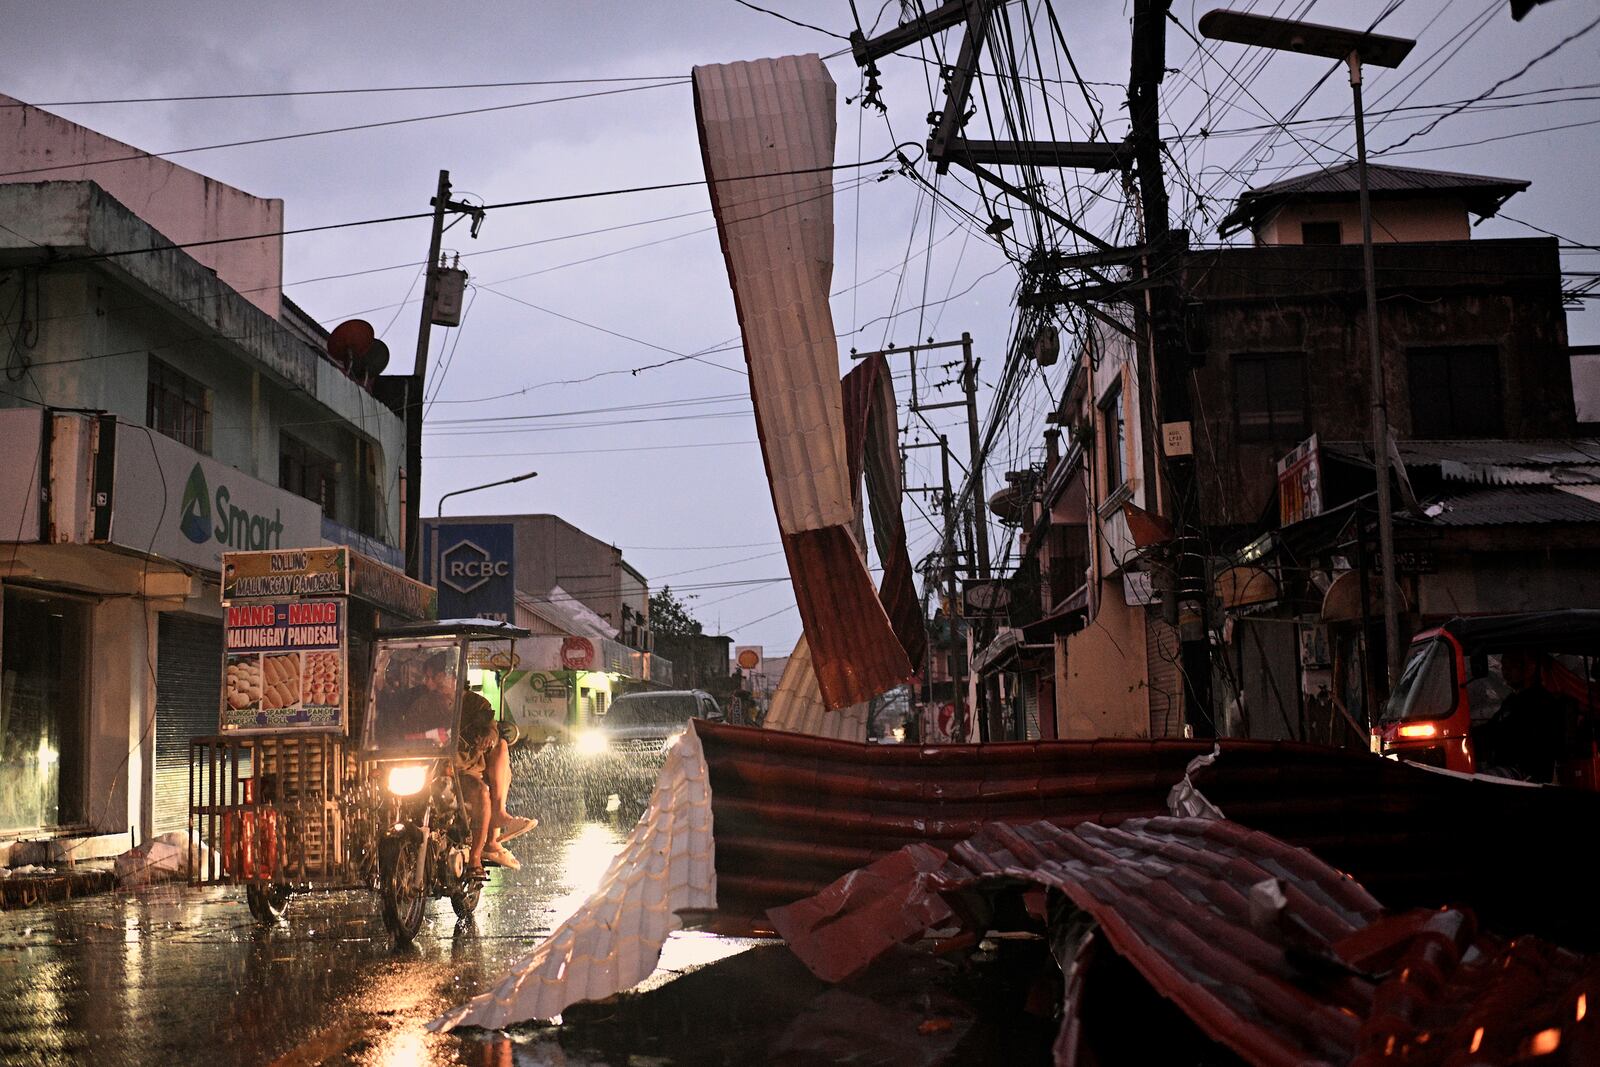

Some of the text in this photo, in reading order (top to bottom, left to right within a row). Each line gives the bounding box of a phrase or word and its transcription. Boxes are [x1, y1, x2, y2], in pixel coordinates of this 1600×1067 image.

[214, 485, 284, 551] Smart
[270, 552, 307, 572] ROLLING
[451, 561, 509, 577] RCBC
[235, 571, 341, 596] MALUNGGAY PANDESAL
[228, 604, 275, 627] NANG
[289, 602, 336, 625] NANG
[476, 613, 508, 621] ATM
[288, 626, 338, 645] PANDESAL
[267, 716, 288, 724] ROLL
